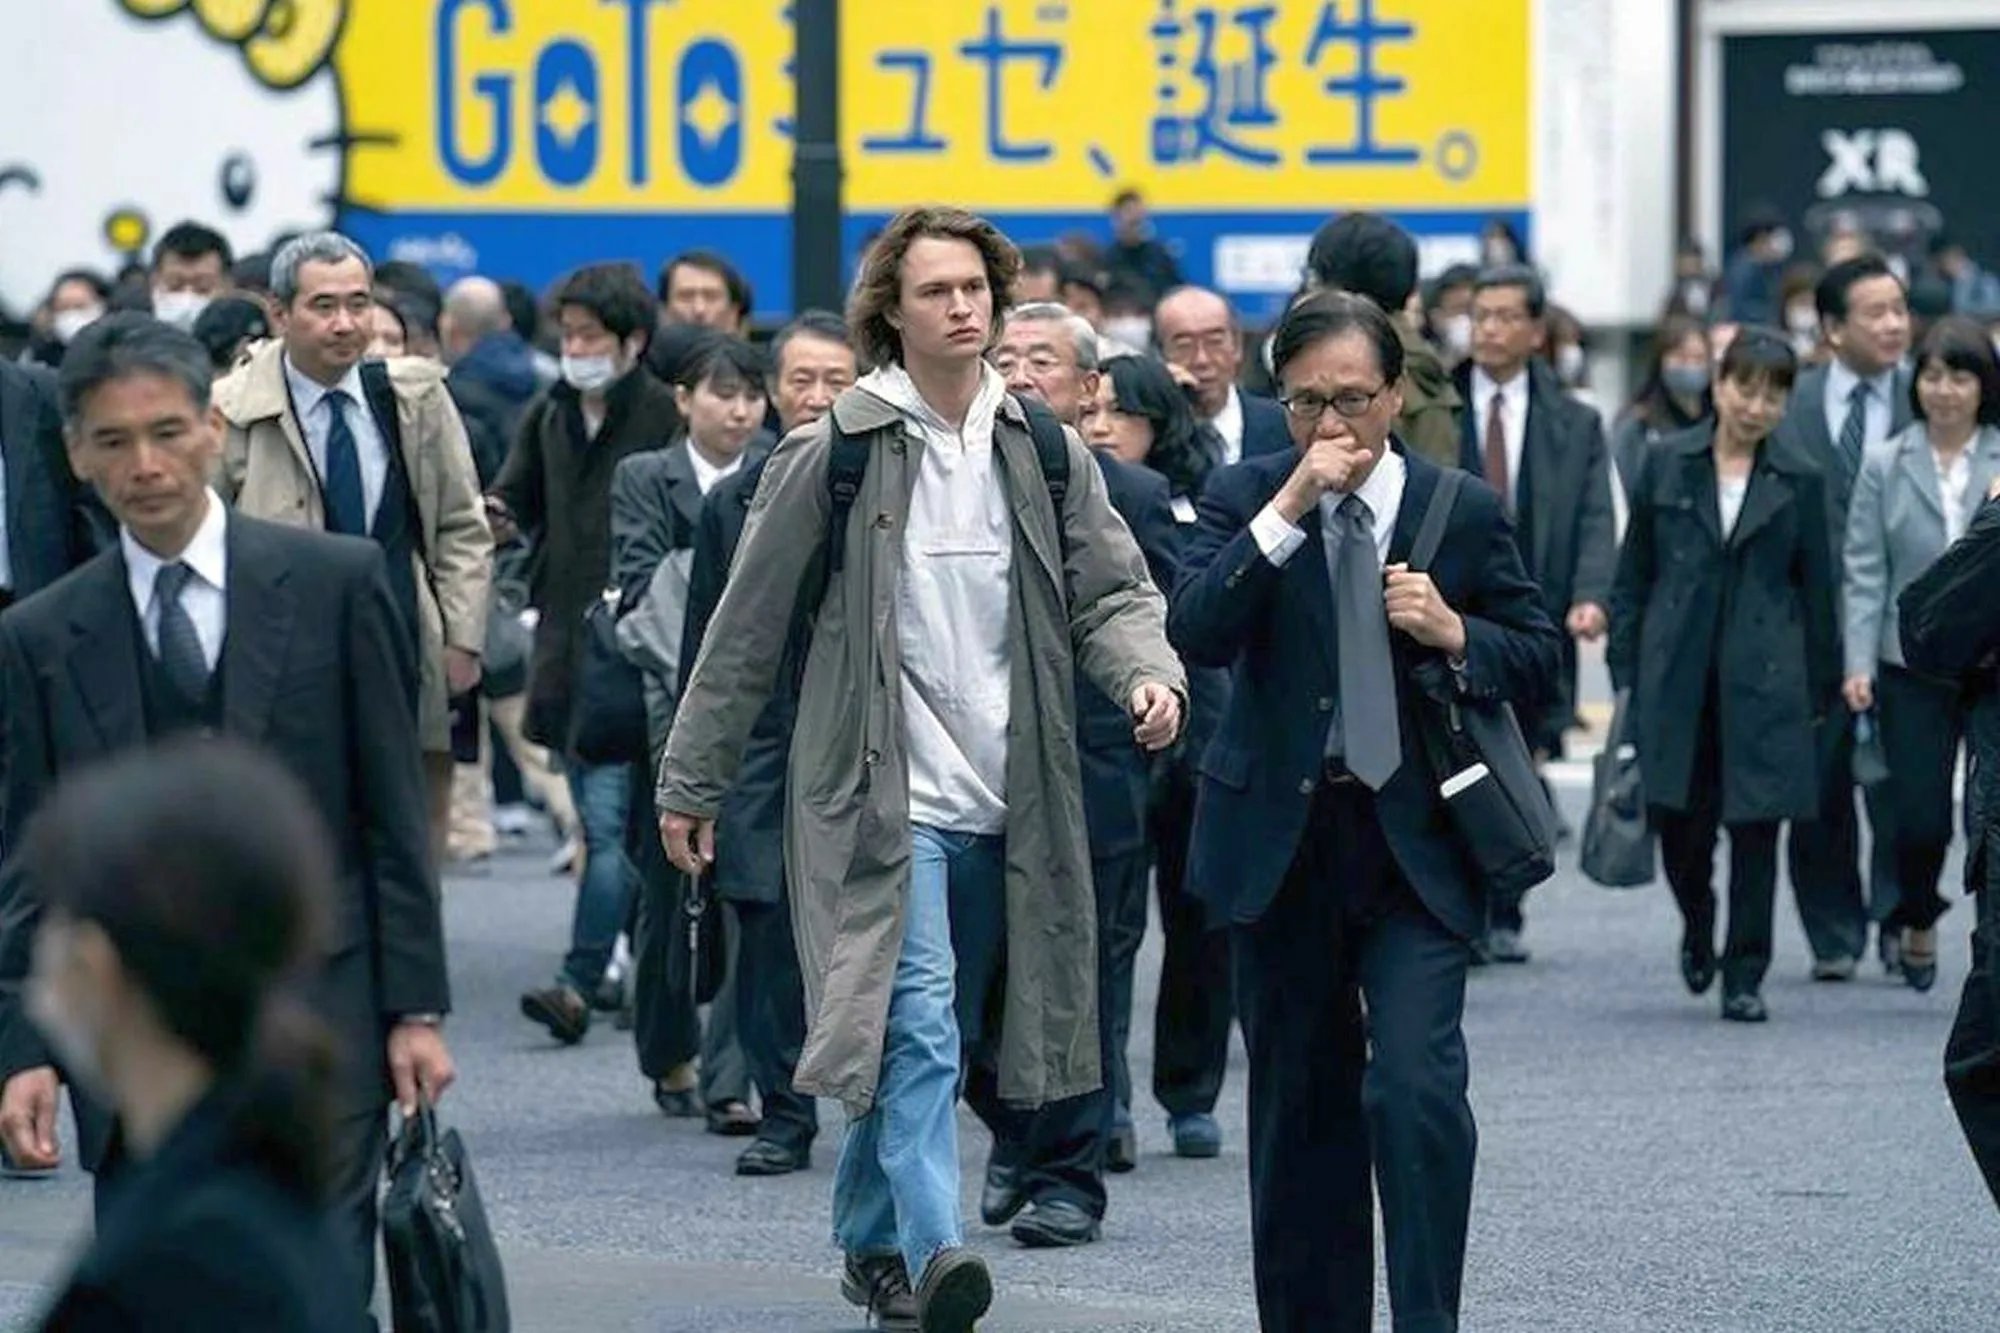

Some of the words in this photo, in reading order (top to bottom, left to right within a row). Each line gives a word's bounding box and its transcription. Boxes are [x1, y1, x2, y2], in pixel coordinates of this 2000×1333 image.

[436, 0, 743, 187] GoTo
[774, 0, 1477, 181] ュゼ、誕生。
